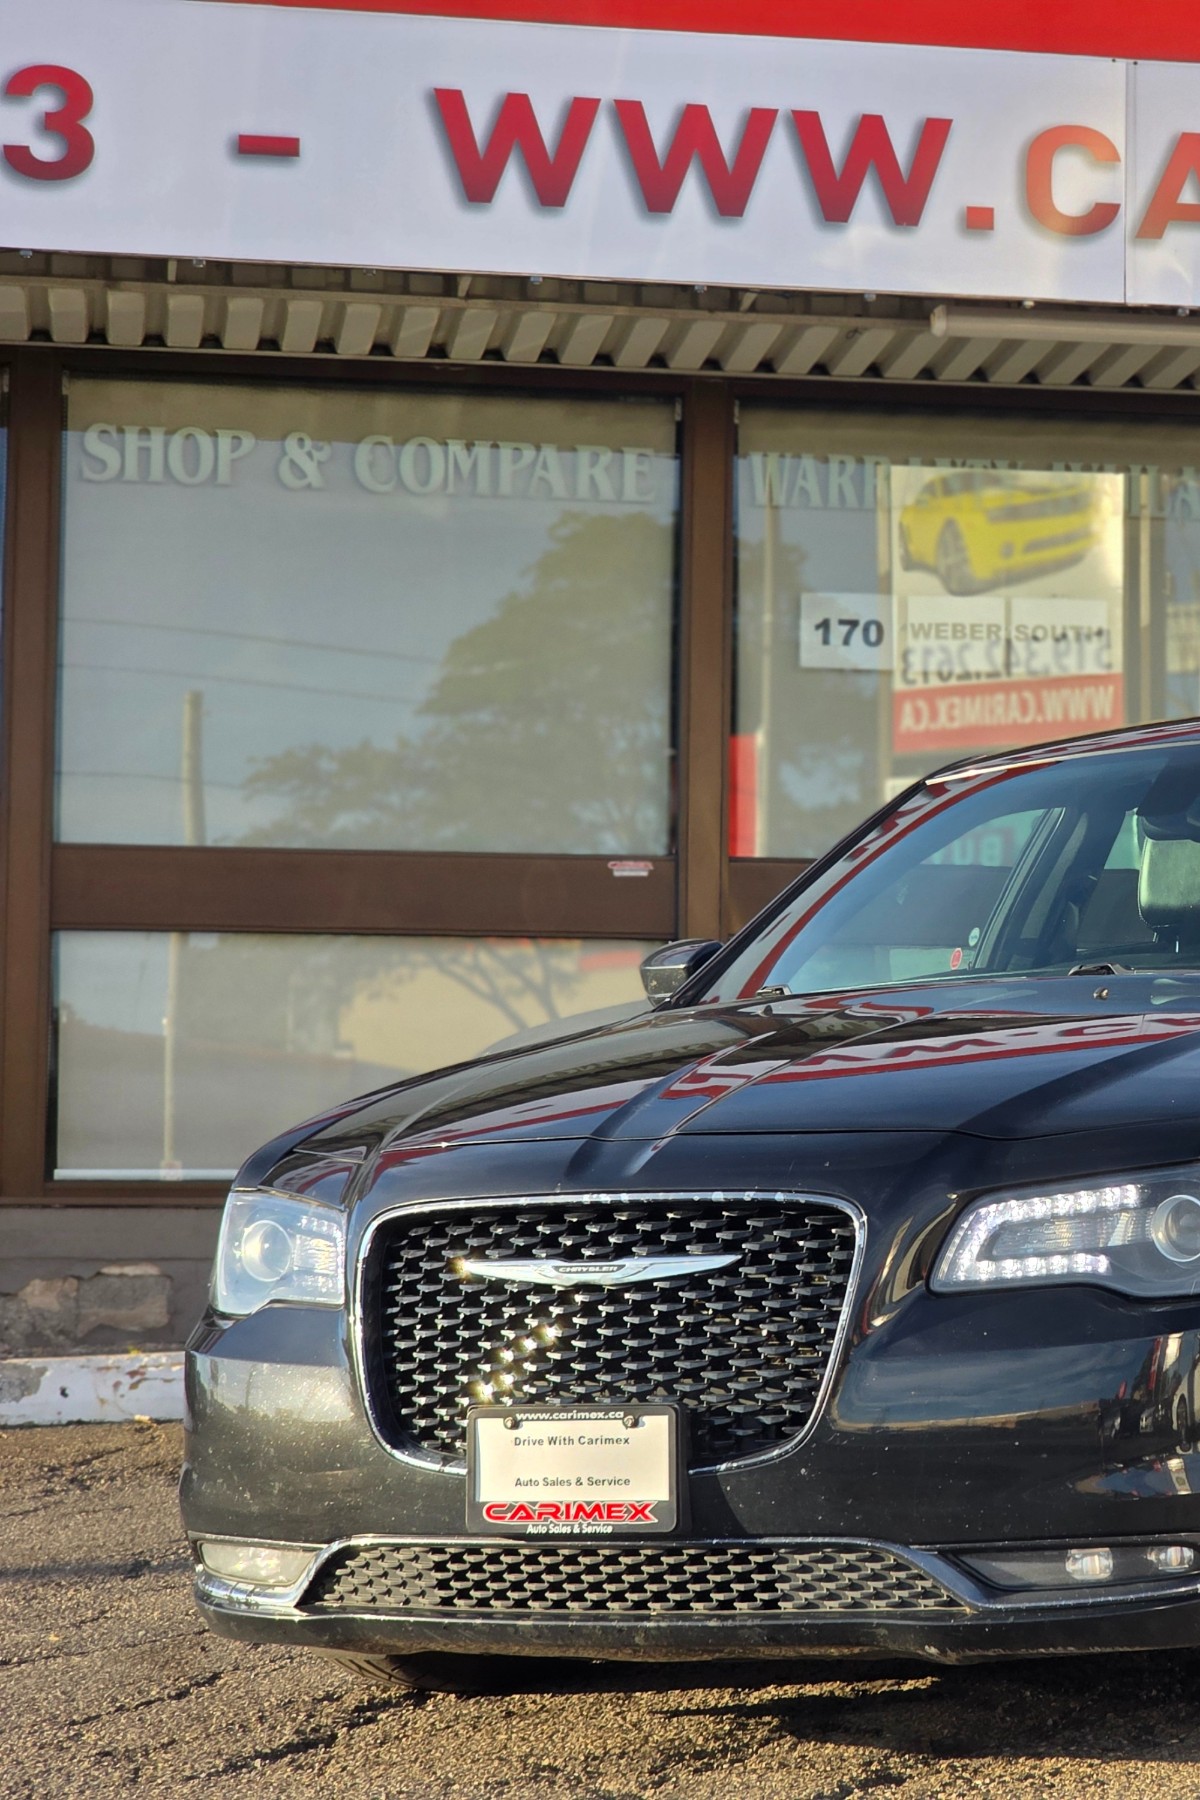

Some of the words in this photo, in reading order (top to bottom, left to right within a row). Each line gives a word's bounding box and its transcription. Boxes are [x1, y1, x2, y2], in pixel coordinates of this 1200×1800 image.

[3, 64, 95, 180] 3
[238, 134, 300, 157] -
[81, 423, 255, 486] SHOP
[277, 431, 331, 490] &
[355, 435, 655, 502] COMPARE
[814, 619, 884, 648] 170
[909, 622, 1002, 642] WEBER
[558, 1265, 618, 1273] CHRYSLER
[516, 1410, 624, 1420] www.carimex.ca
[514, 1436, 544, 1446] Drive
[549, 1436, 574, 1446] With
[578, 1436, 630, 1445] Carimex
[515, 1477, 539, 1487] Auto
[543, 1477, 571, 1487] Sales
[575, 1477, 583, 1486] &
[587, 1477, 630, 1486] Service
[484, 1502, 657, 1522] CARIMEX
[526, 1523, 547, 1534] Auto
[549, 1523, 571, 1534] Sales
[573, 1524, 580, 1533] &
[582, 1524, 613, 1534] Service
